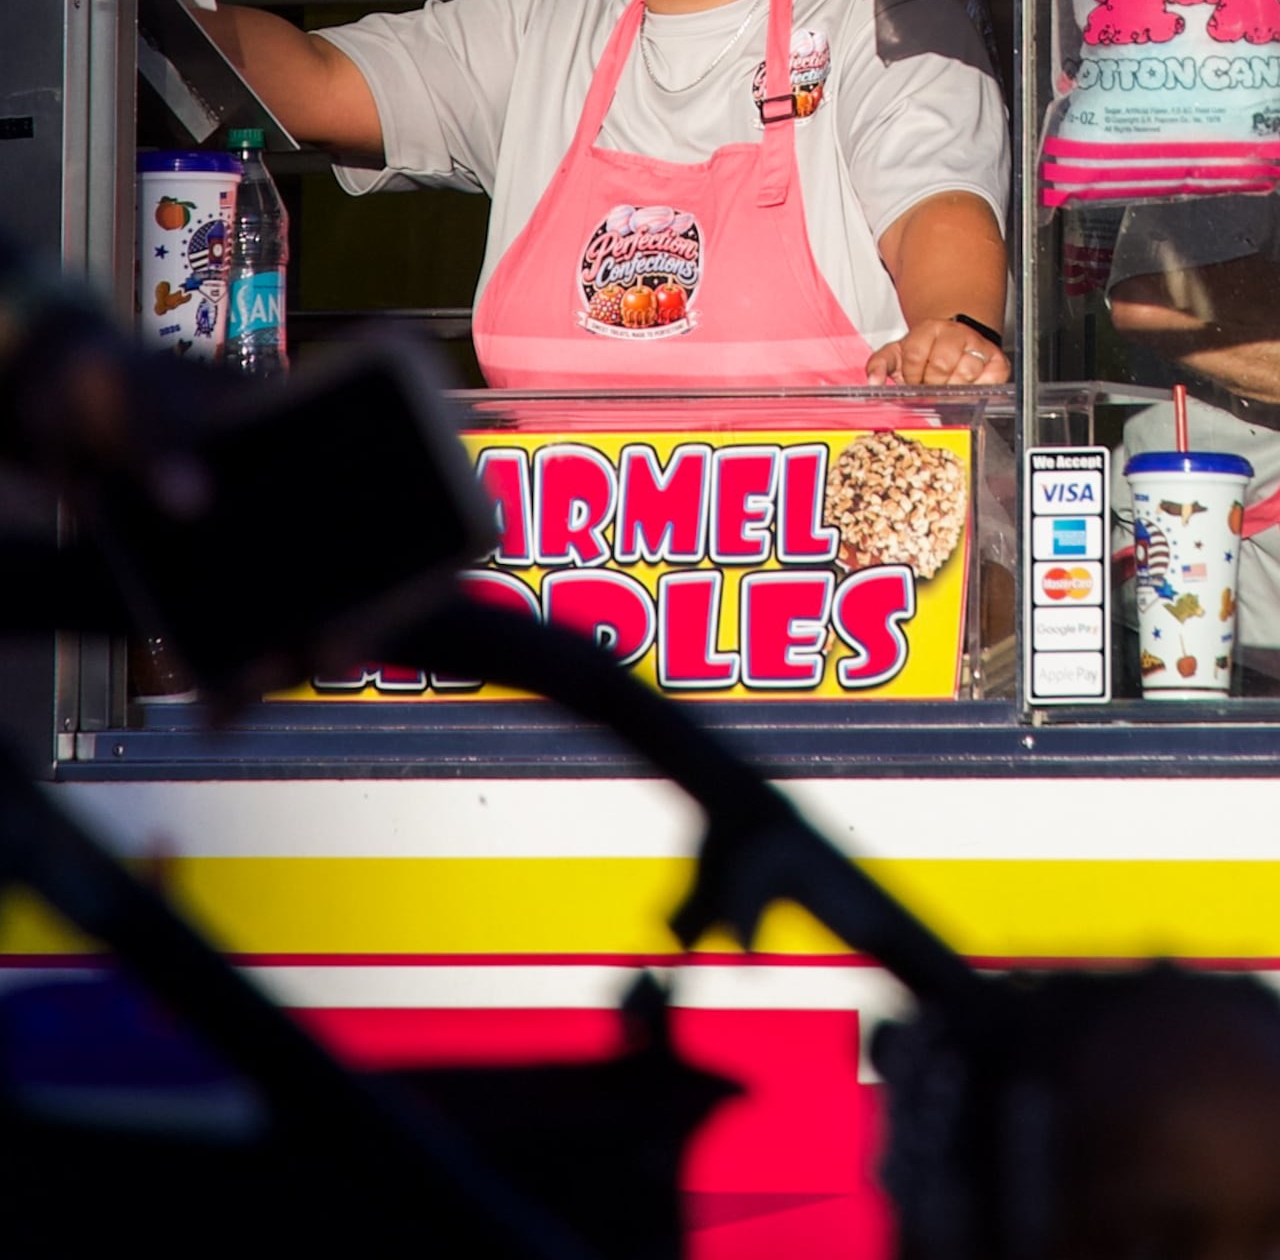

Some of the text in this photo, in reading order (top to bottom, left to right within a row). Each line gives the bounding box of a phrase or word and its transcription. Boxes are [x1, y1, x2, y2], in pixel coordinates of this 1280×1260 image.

[581, 226, 699, 282] Perfection
[596, 255, 699, 288] Confections
[1032, 454, 1103, 470] We Accept
[473, 442, 839, 567] ARMEL
[1041, 482, 1095, 503] VISA
